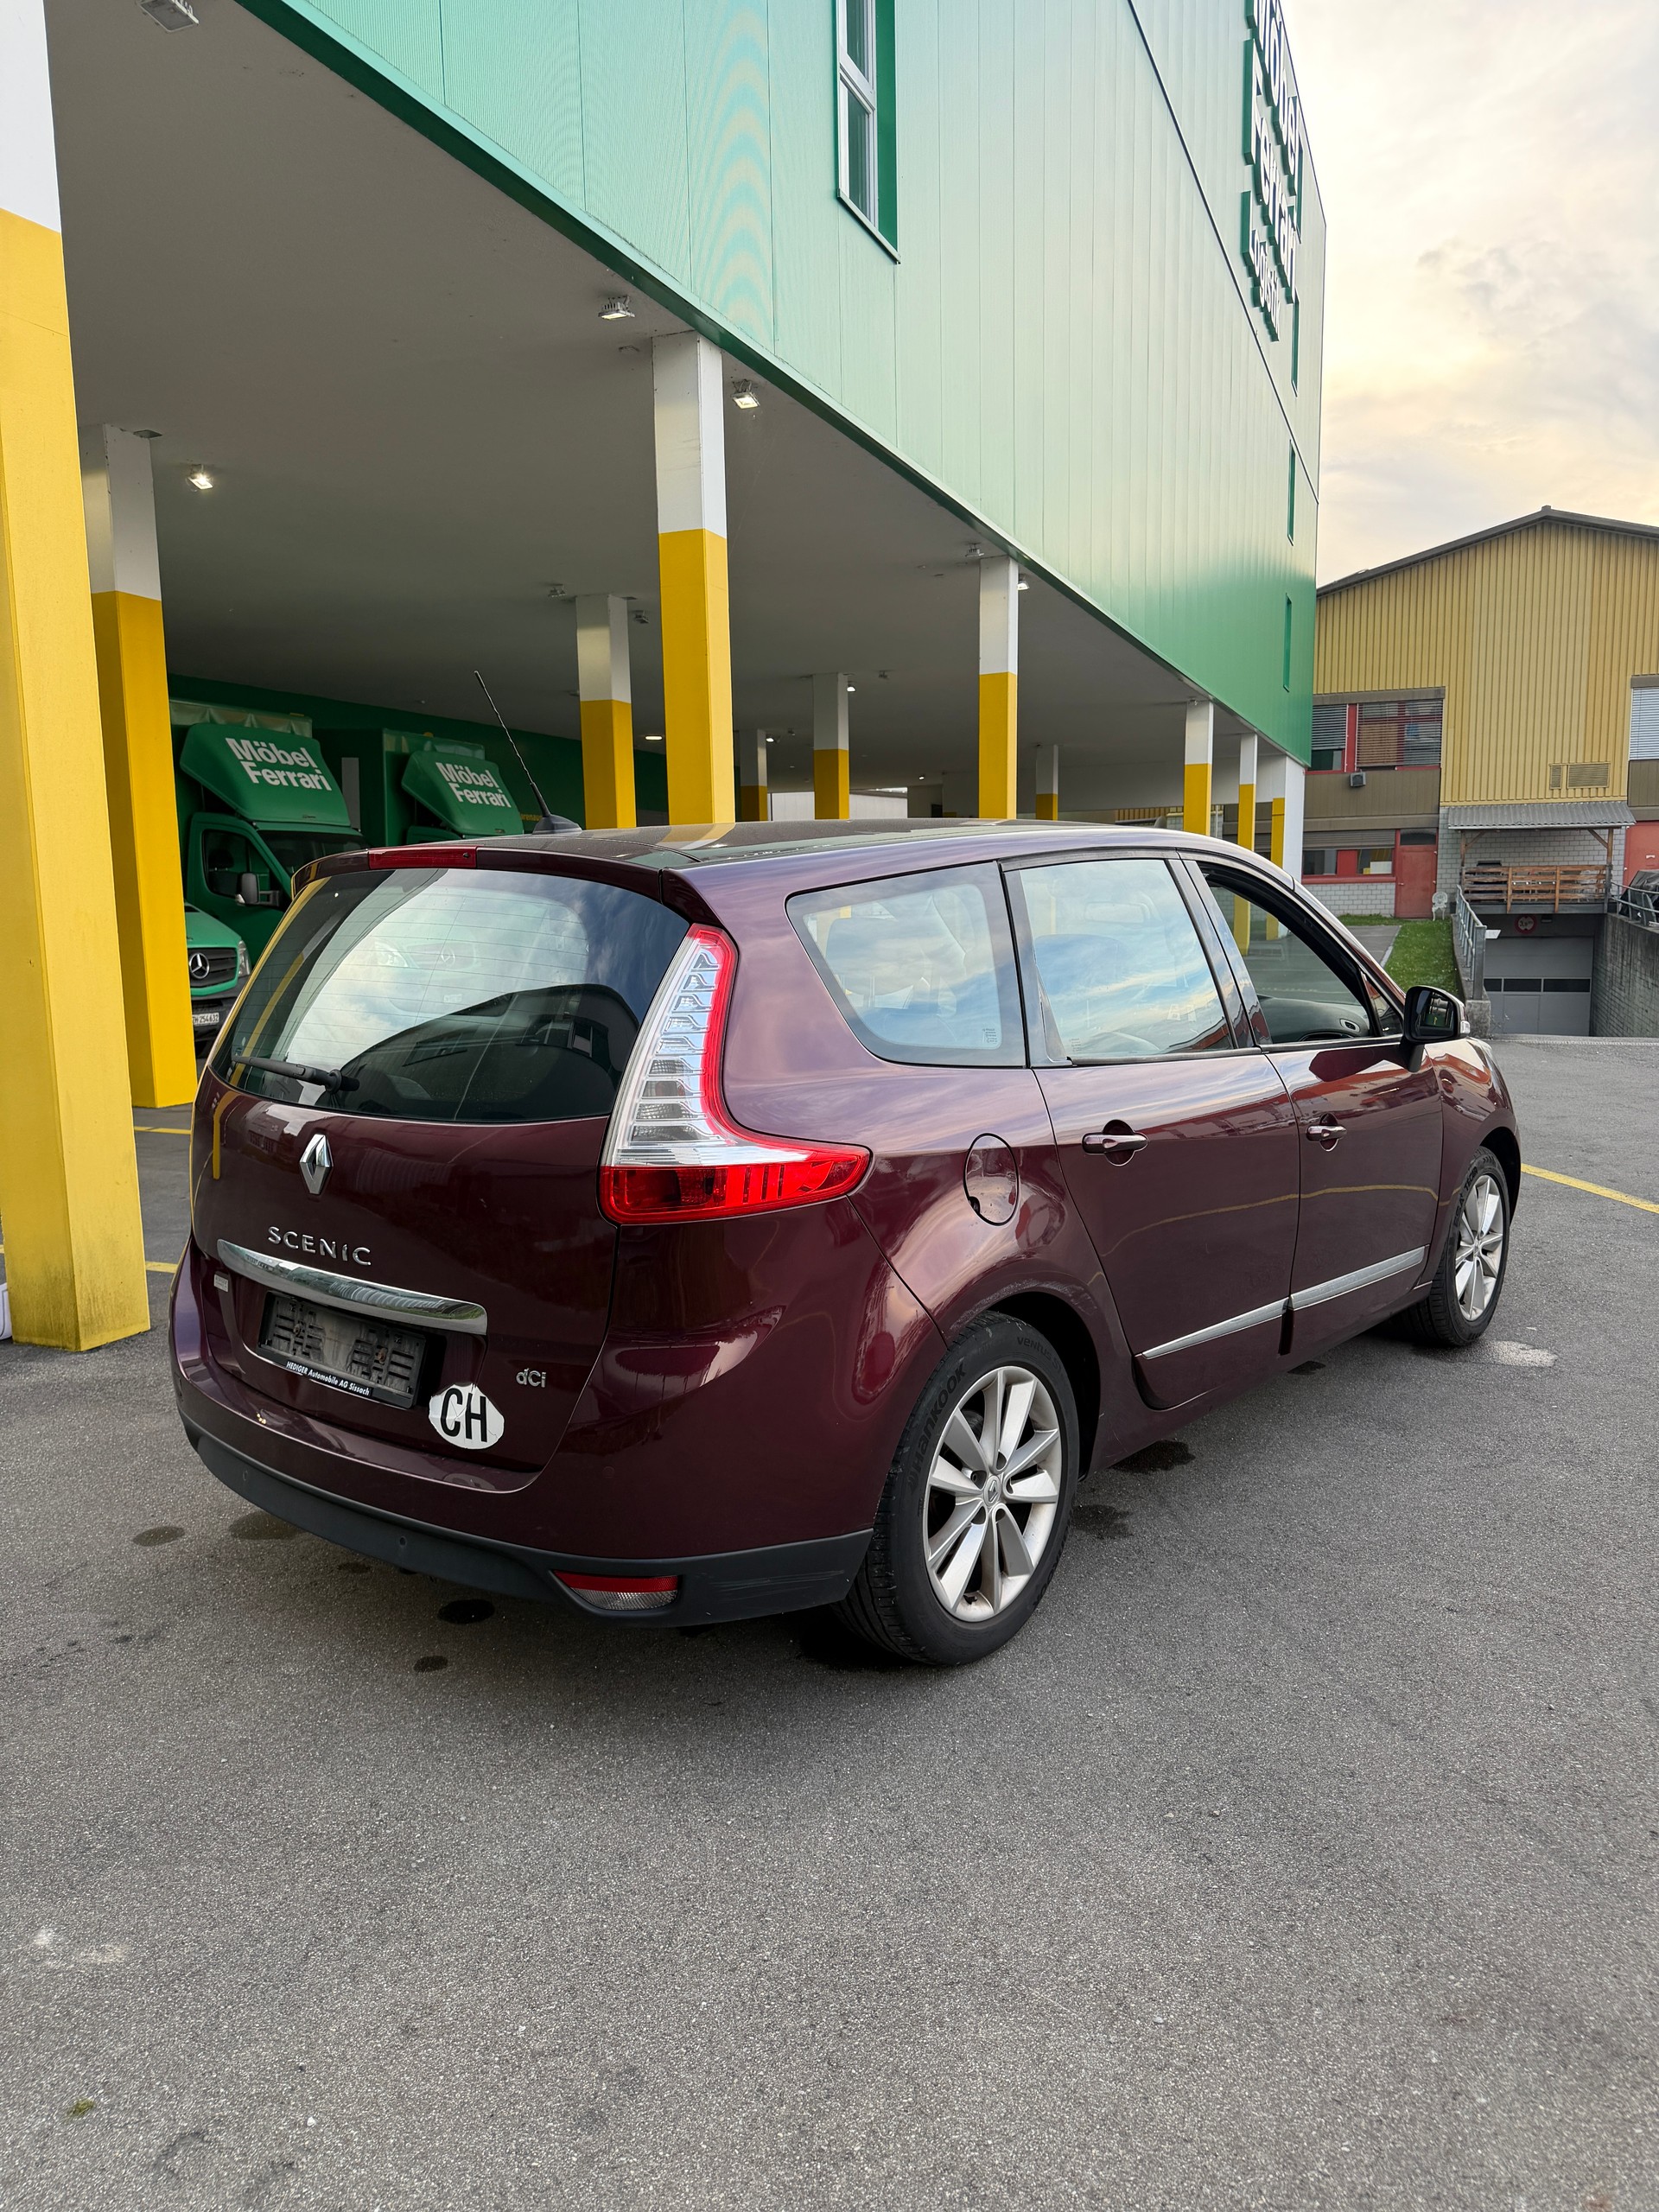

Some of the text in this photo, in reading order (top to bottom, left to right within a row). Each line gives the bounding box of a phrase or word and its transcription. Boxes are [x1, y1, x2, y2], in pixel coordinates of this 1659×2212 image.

[1250, 38, 1297, 303] Ferrari
[1249, 191, 1281, 340] Logistik
[226, 737, 319, 769] Möbel
[240, 761, 332, 792] Ferrari
[435, 761, 499, 789] Möbel
[448, 782, 512, 809] Ferrari
[268, 1226, 372, 1267] SCENIC
[286, 1361, 370, 1396] HEDIGER Automobile AG Sissach
[441, 1387, 488, 1443] CH
